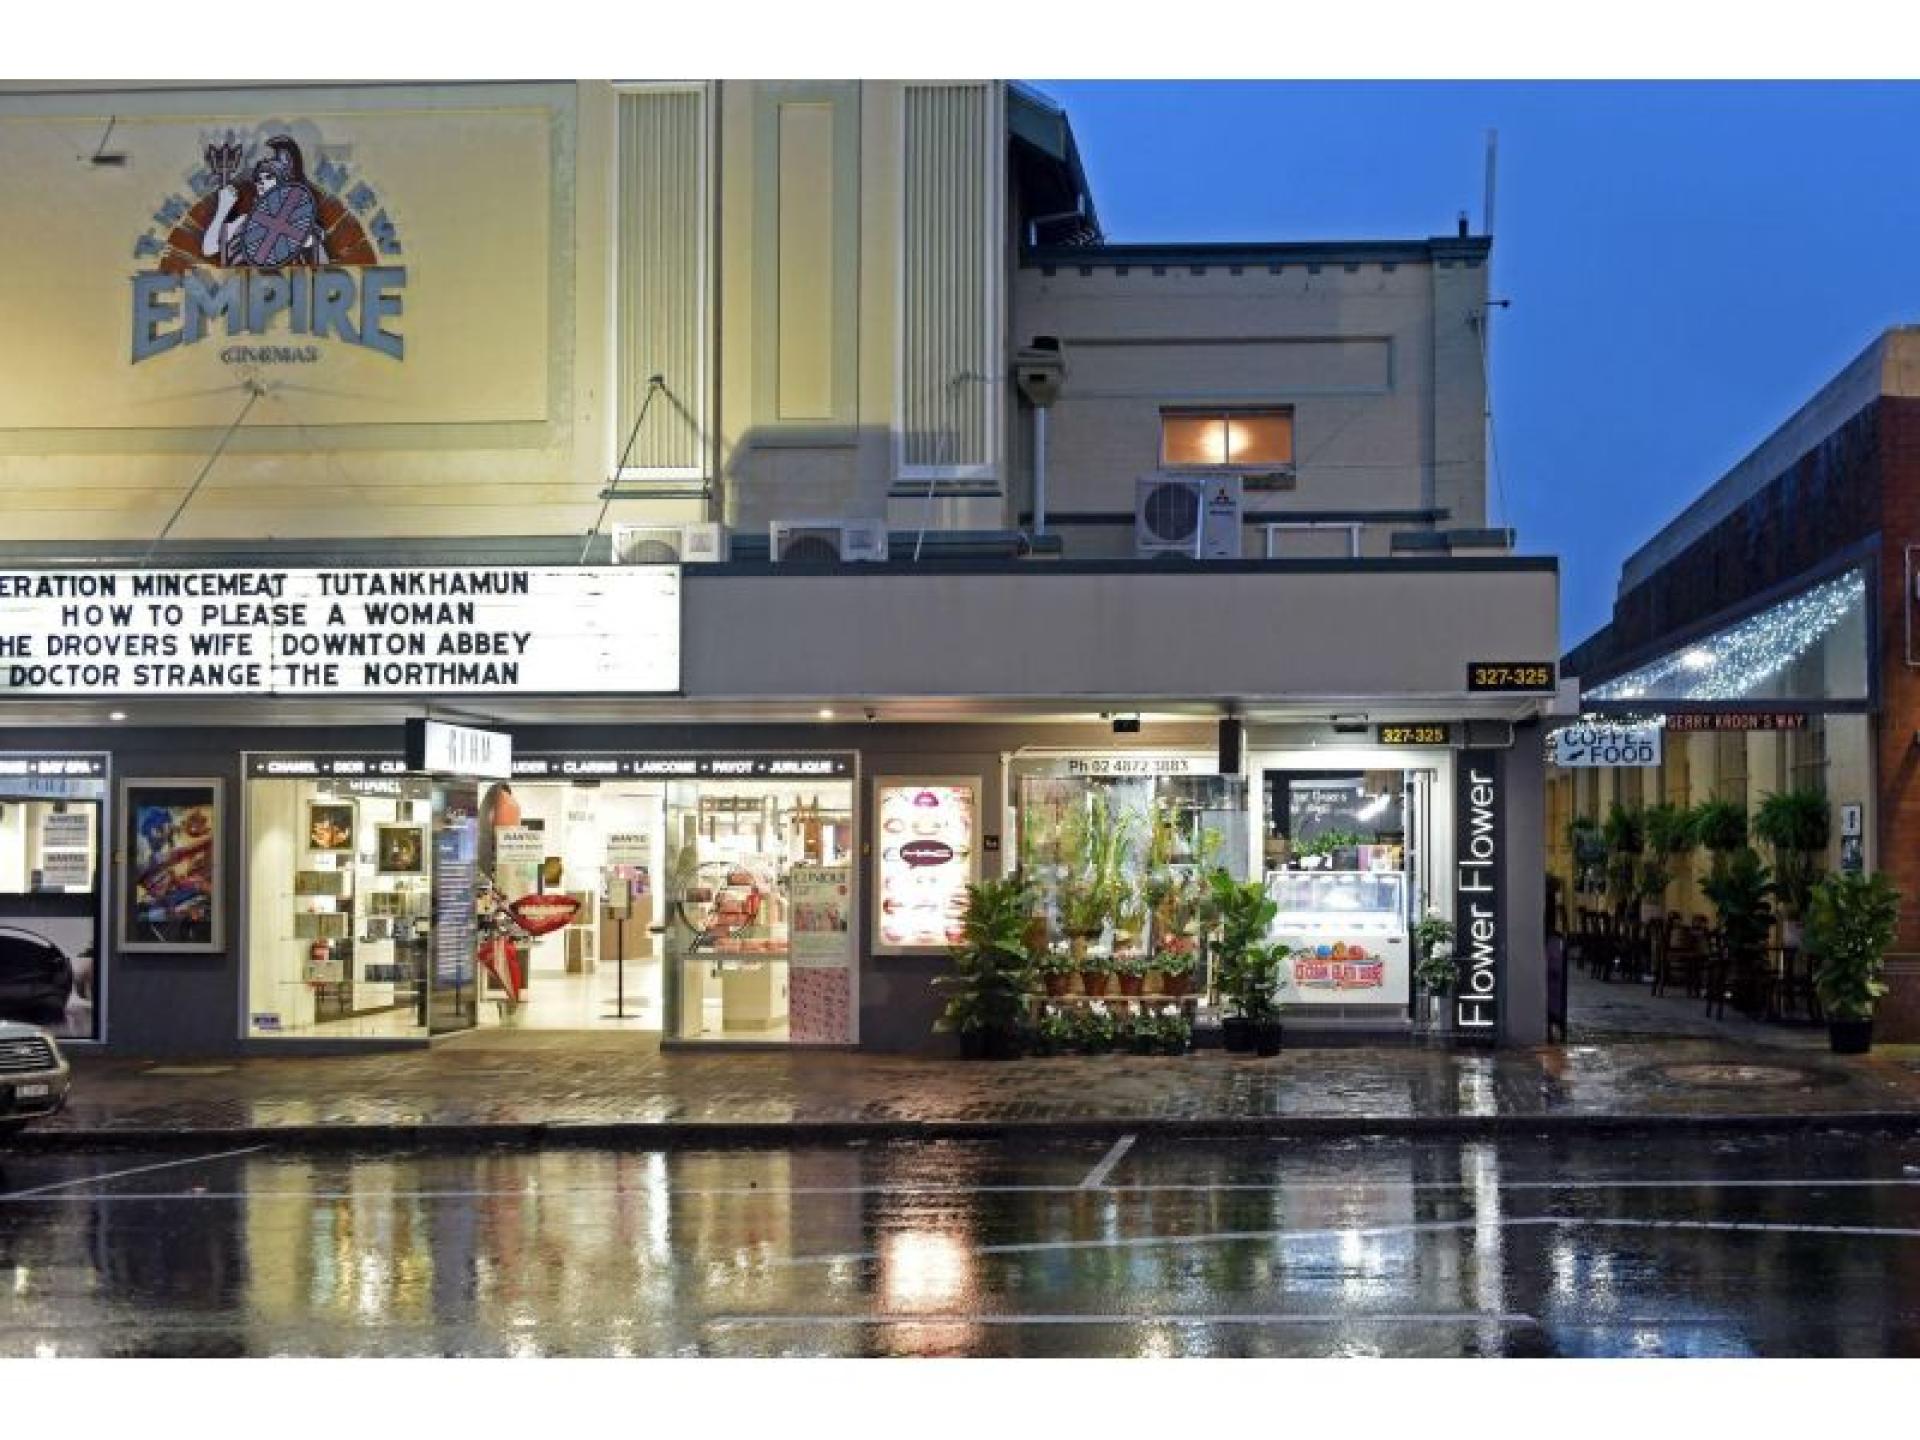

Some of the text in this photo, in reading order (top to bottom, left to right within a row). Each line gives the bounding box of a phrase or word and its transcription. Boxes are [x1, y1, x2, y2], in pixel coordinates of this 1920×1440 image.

[131, 266, 406, 366] EMPIRE
[0, 571, 529, 597] ERATION MINCEMEAT TUTANKHAMUN
[61, 602, 474, 626] HOW TO PLEASE A WOMAN
[47, 634, 178, 656] DROVERS
[190, 633, 252, 655] WIFE
[282, 633, 425, 655] DOWNTON
[436, 632, 531, 655] ABBEY
[9, 662, 519, 687] DOCTOR STRANGE THE NORTHMAN
[1475, 668, 1548, 685] 327-325
[1069, 760, 1088, 772] Ph
[1590, 746, 1653, 763] FOOD
[1459, 769, 1494, 1025] Flower Flower
